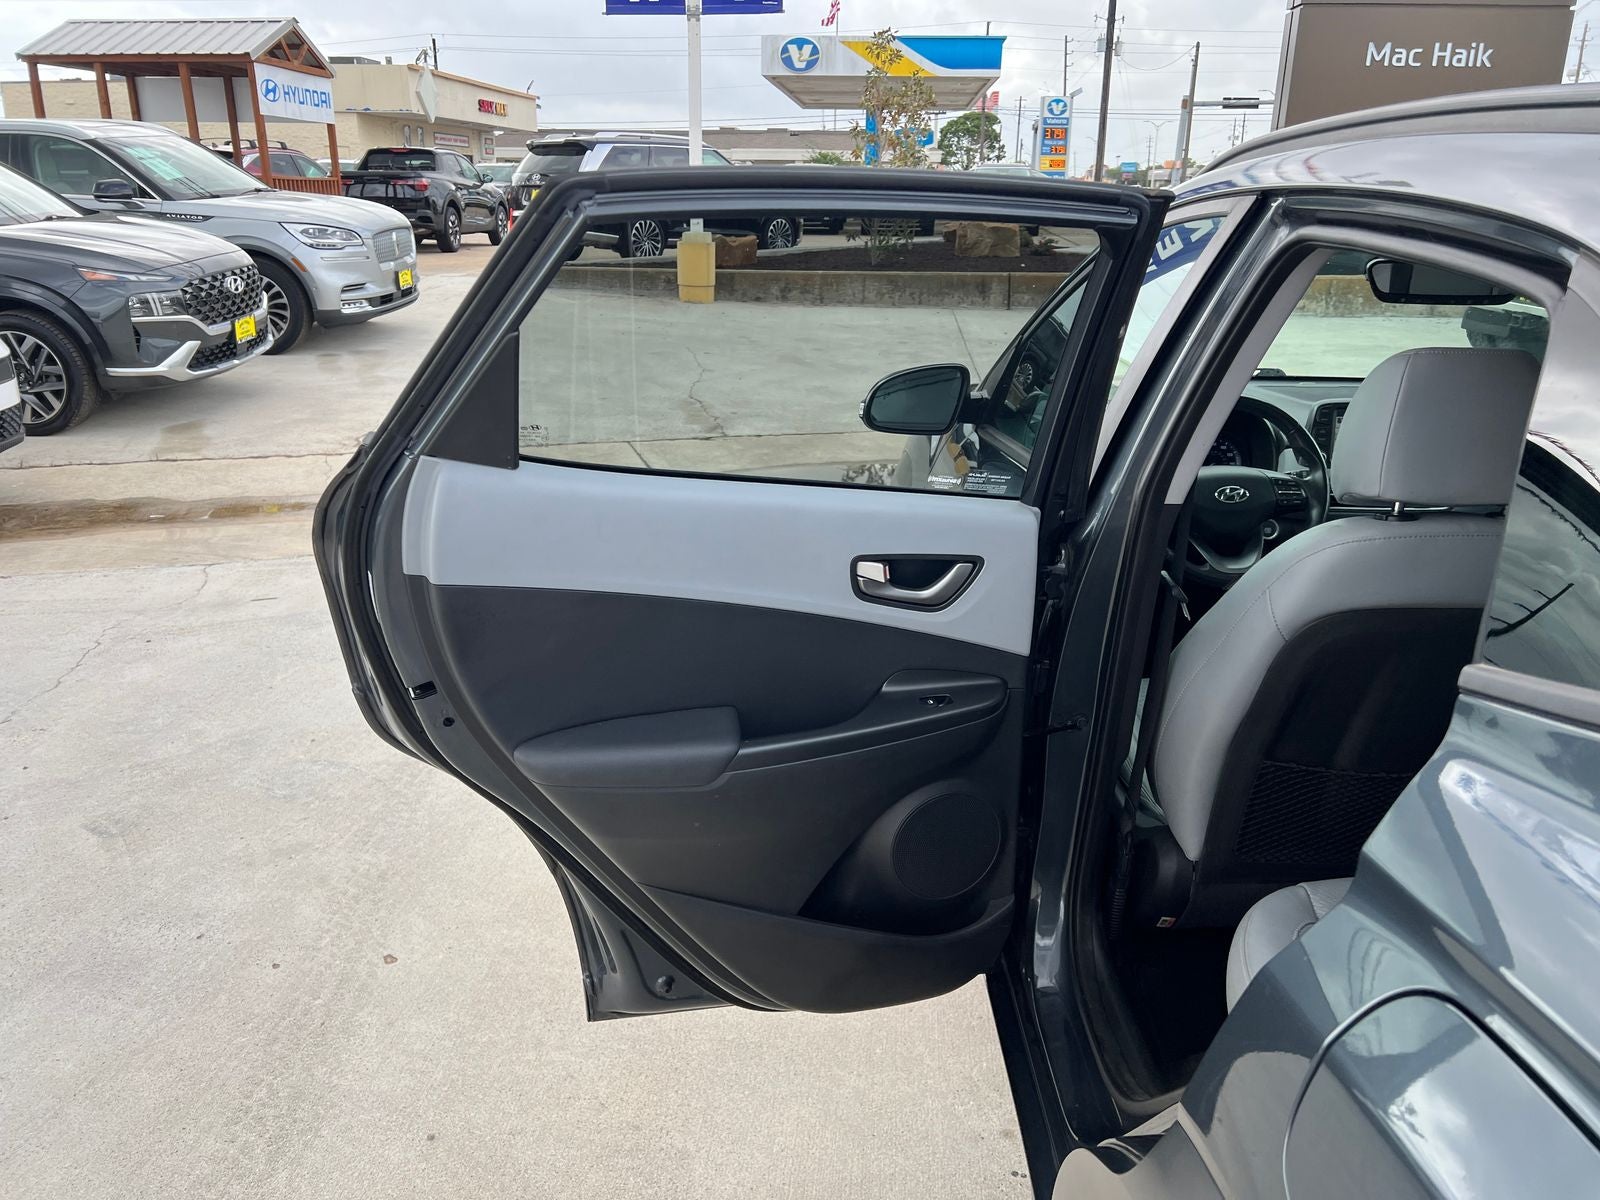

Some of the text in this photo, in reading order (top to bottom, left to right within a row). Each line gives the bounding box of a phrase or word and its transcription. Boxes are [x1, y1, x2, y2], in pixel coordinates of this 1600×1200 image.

[1365, 41, 1494, 68] Mac Haik
[281, 84, 332, 110] HYUNDAI
